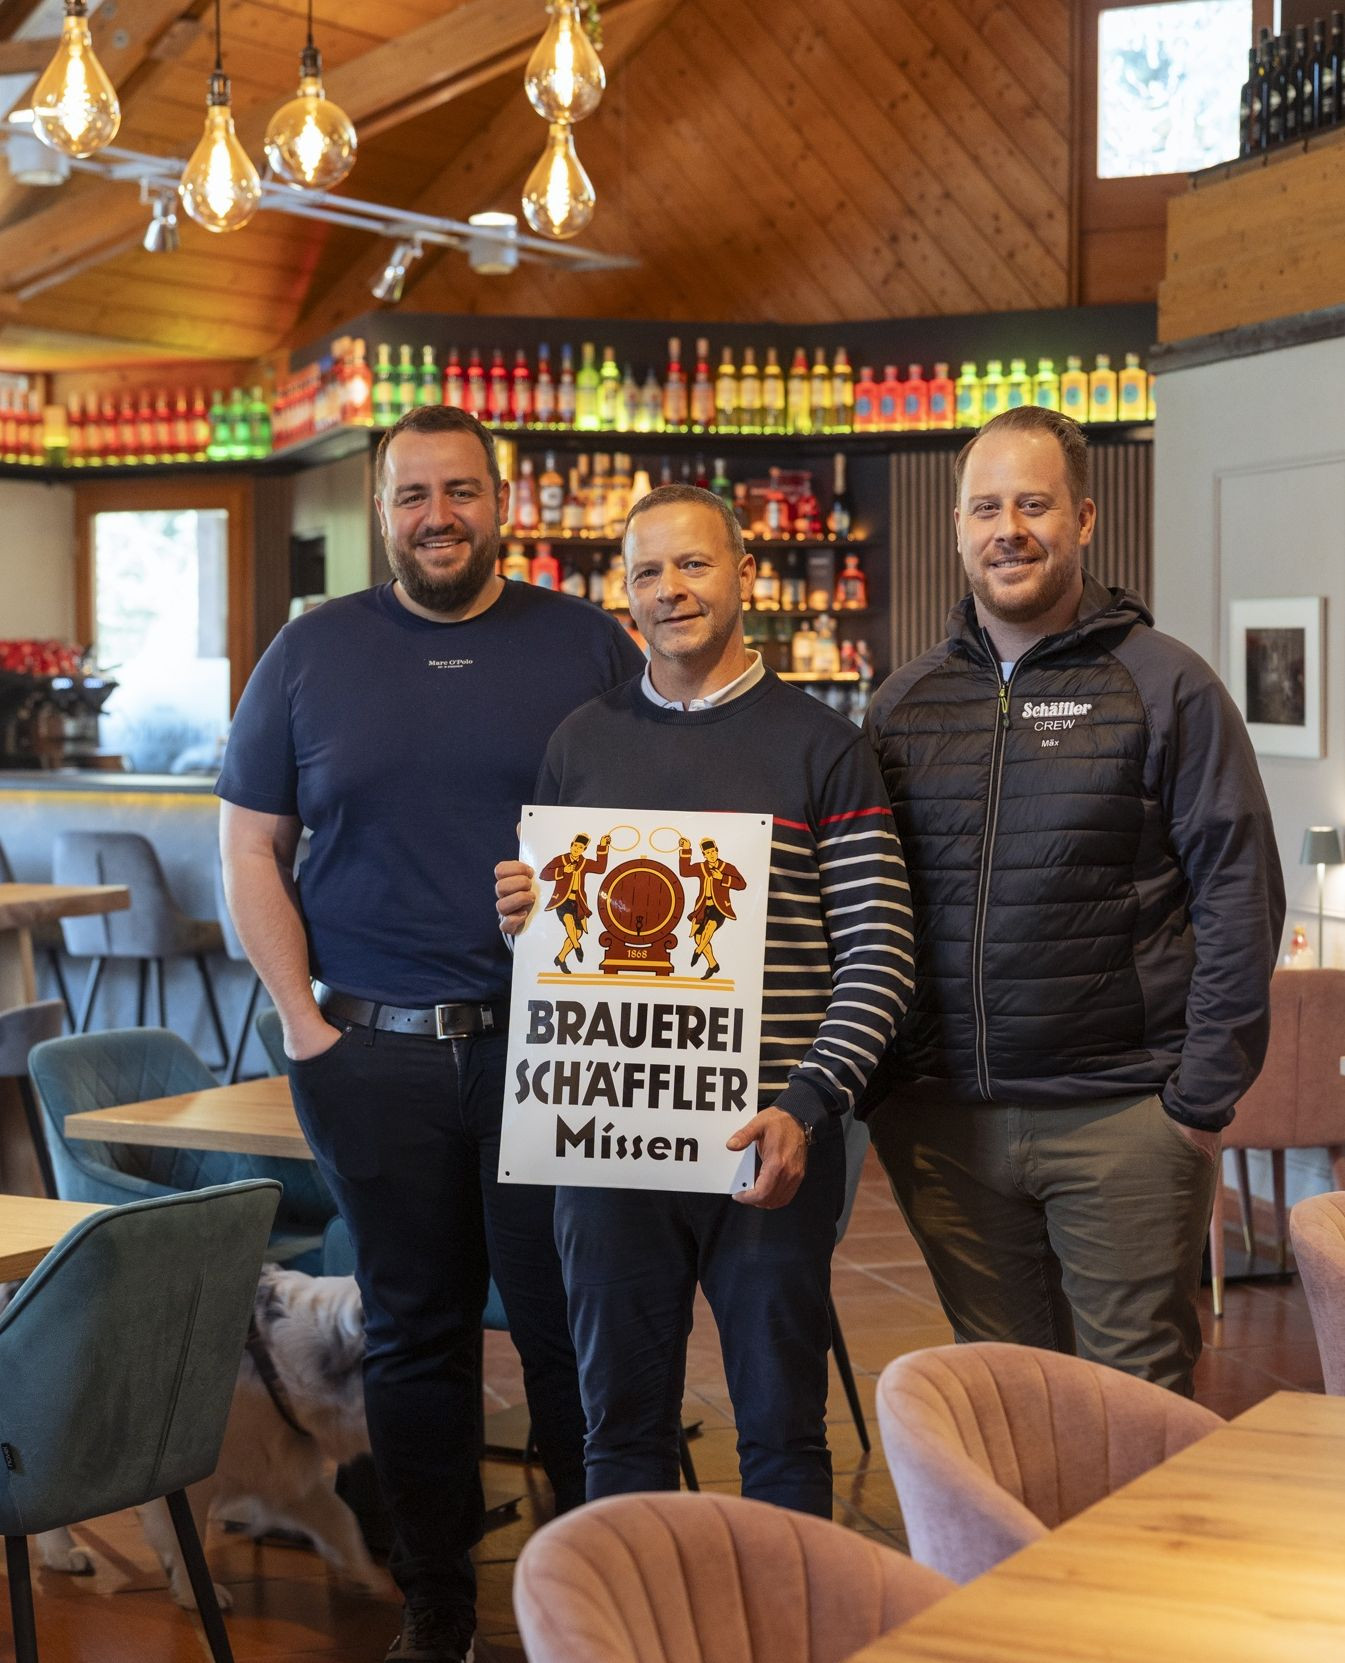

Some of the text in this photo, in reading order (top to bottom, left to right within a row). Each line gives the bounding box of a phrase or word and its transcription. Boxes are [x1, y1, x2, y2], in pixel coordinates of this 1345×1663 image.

[1022, 701, 1092, 719] Schäffler
[1034, 719, 1076, 731] CREW
[627, 949, 648, 959] 1868
[526, 1000, 744, 1053] BRAUEREI
[515, 1058, 748, 1112] SCHÄFFLER
[556, 1114, 698, 1162] Missen
